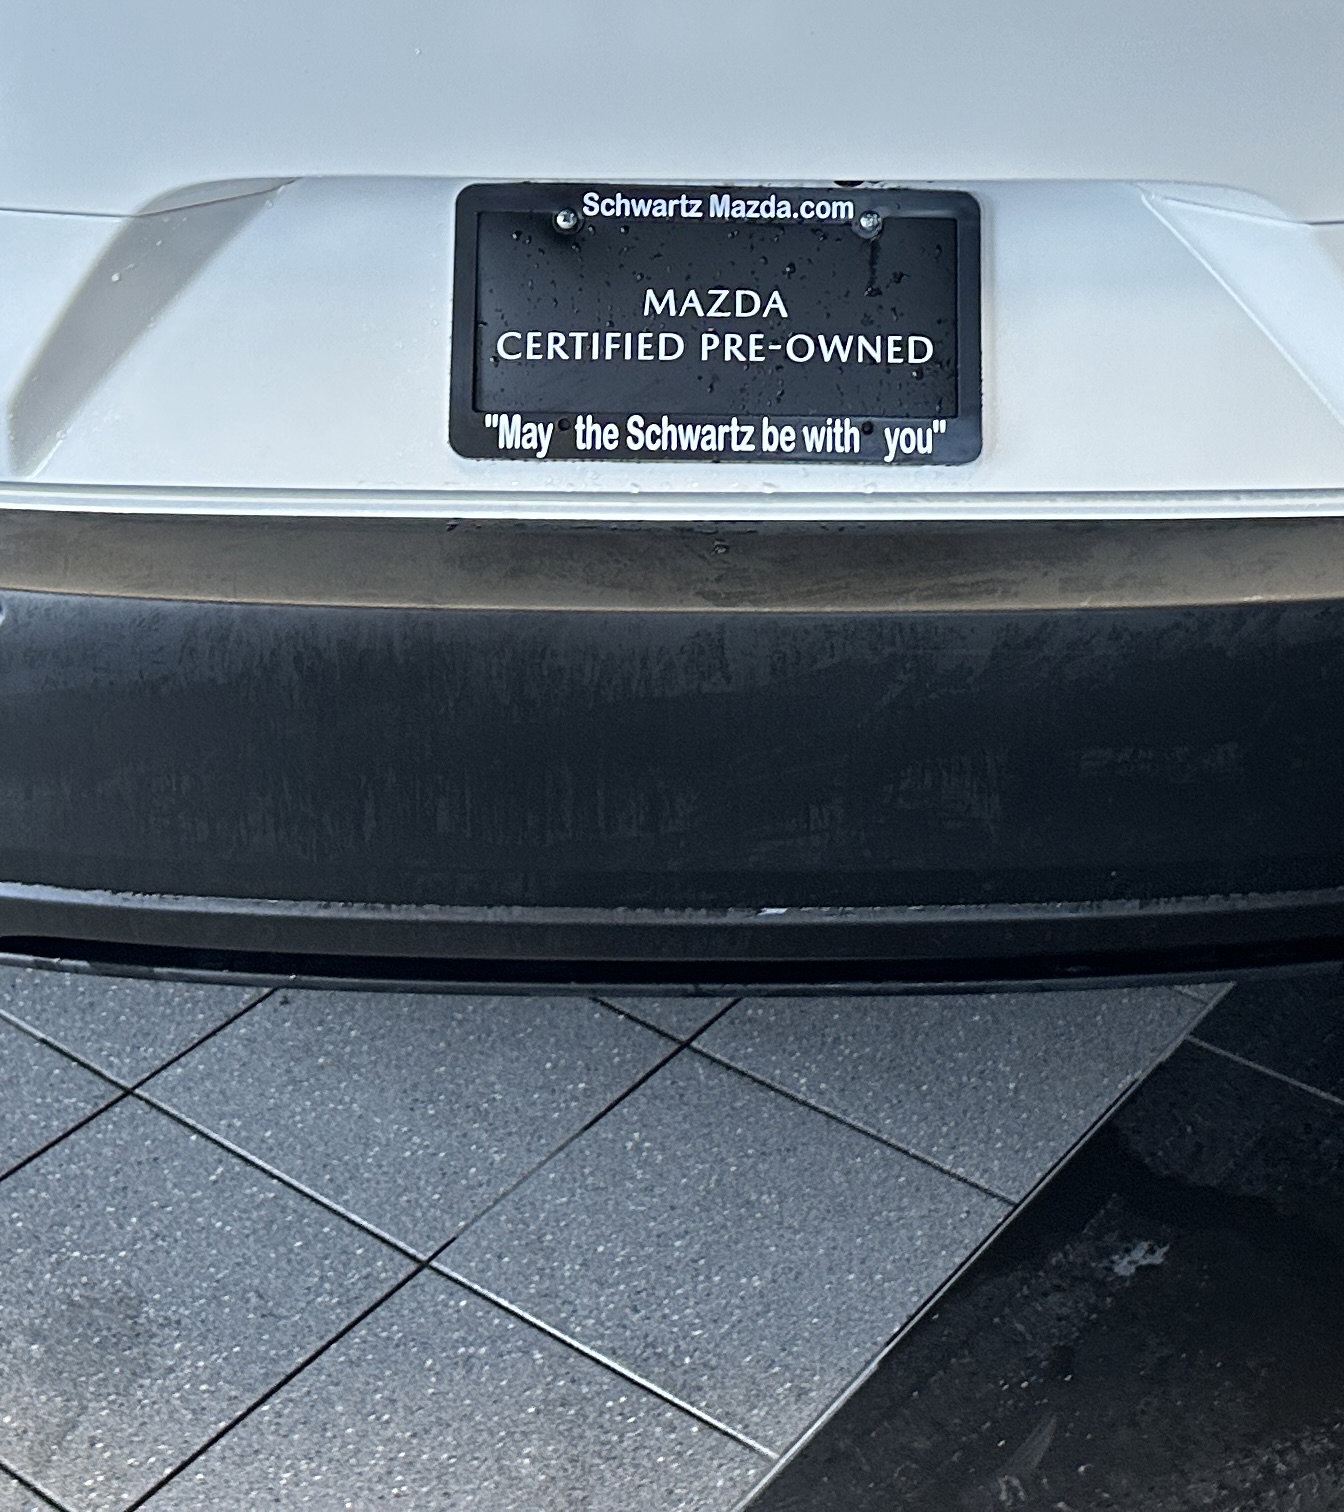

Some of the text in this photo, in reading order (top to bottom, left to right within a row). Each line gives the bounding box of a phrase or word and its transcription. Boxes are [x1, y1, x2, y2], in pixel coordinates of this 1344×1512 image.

[582, 192, 855, 220] Schwartz Mazda.com
[642, 289, 789, 318] MAZDA
[496, 331, 935, 365] CERTIFIED PRE-OWNED
[484, 413, 948, 463] "May the Schwartz be with you"
